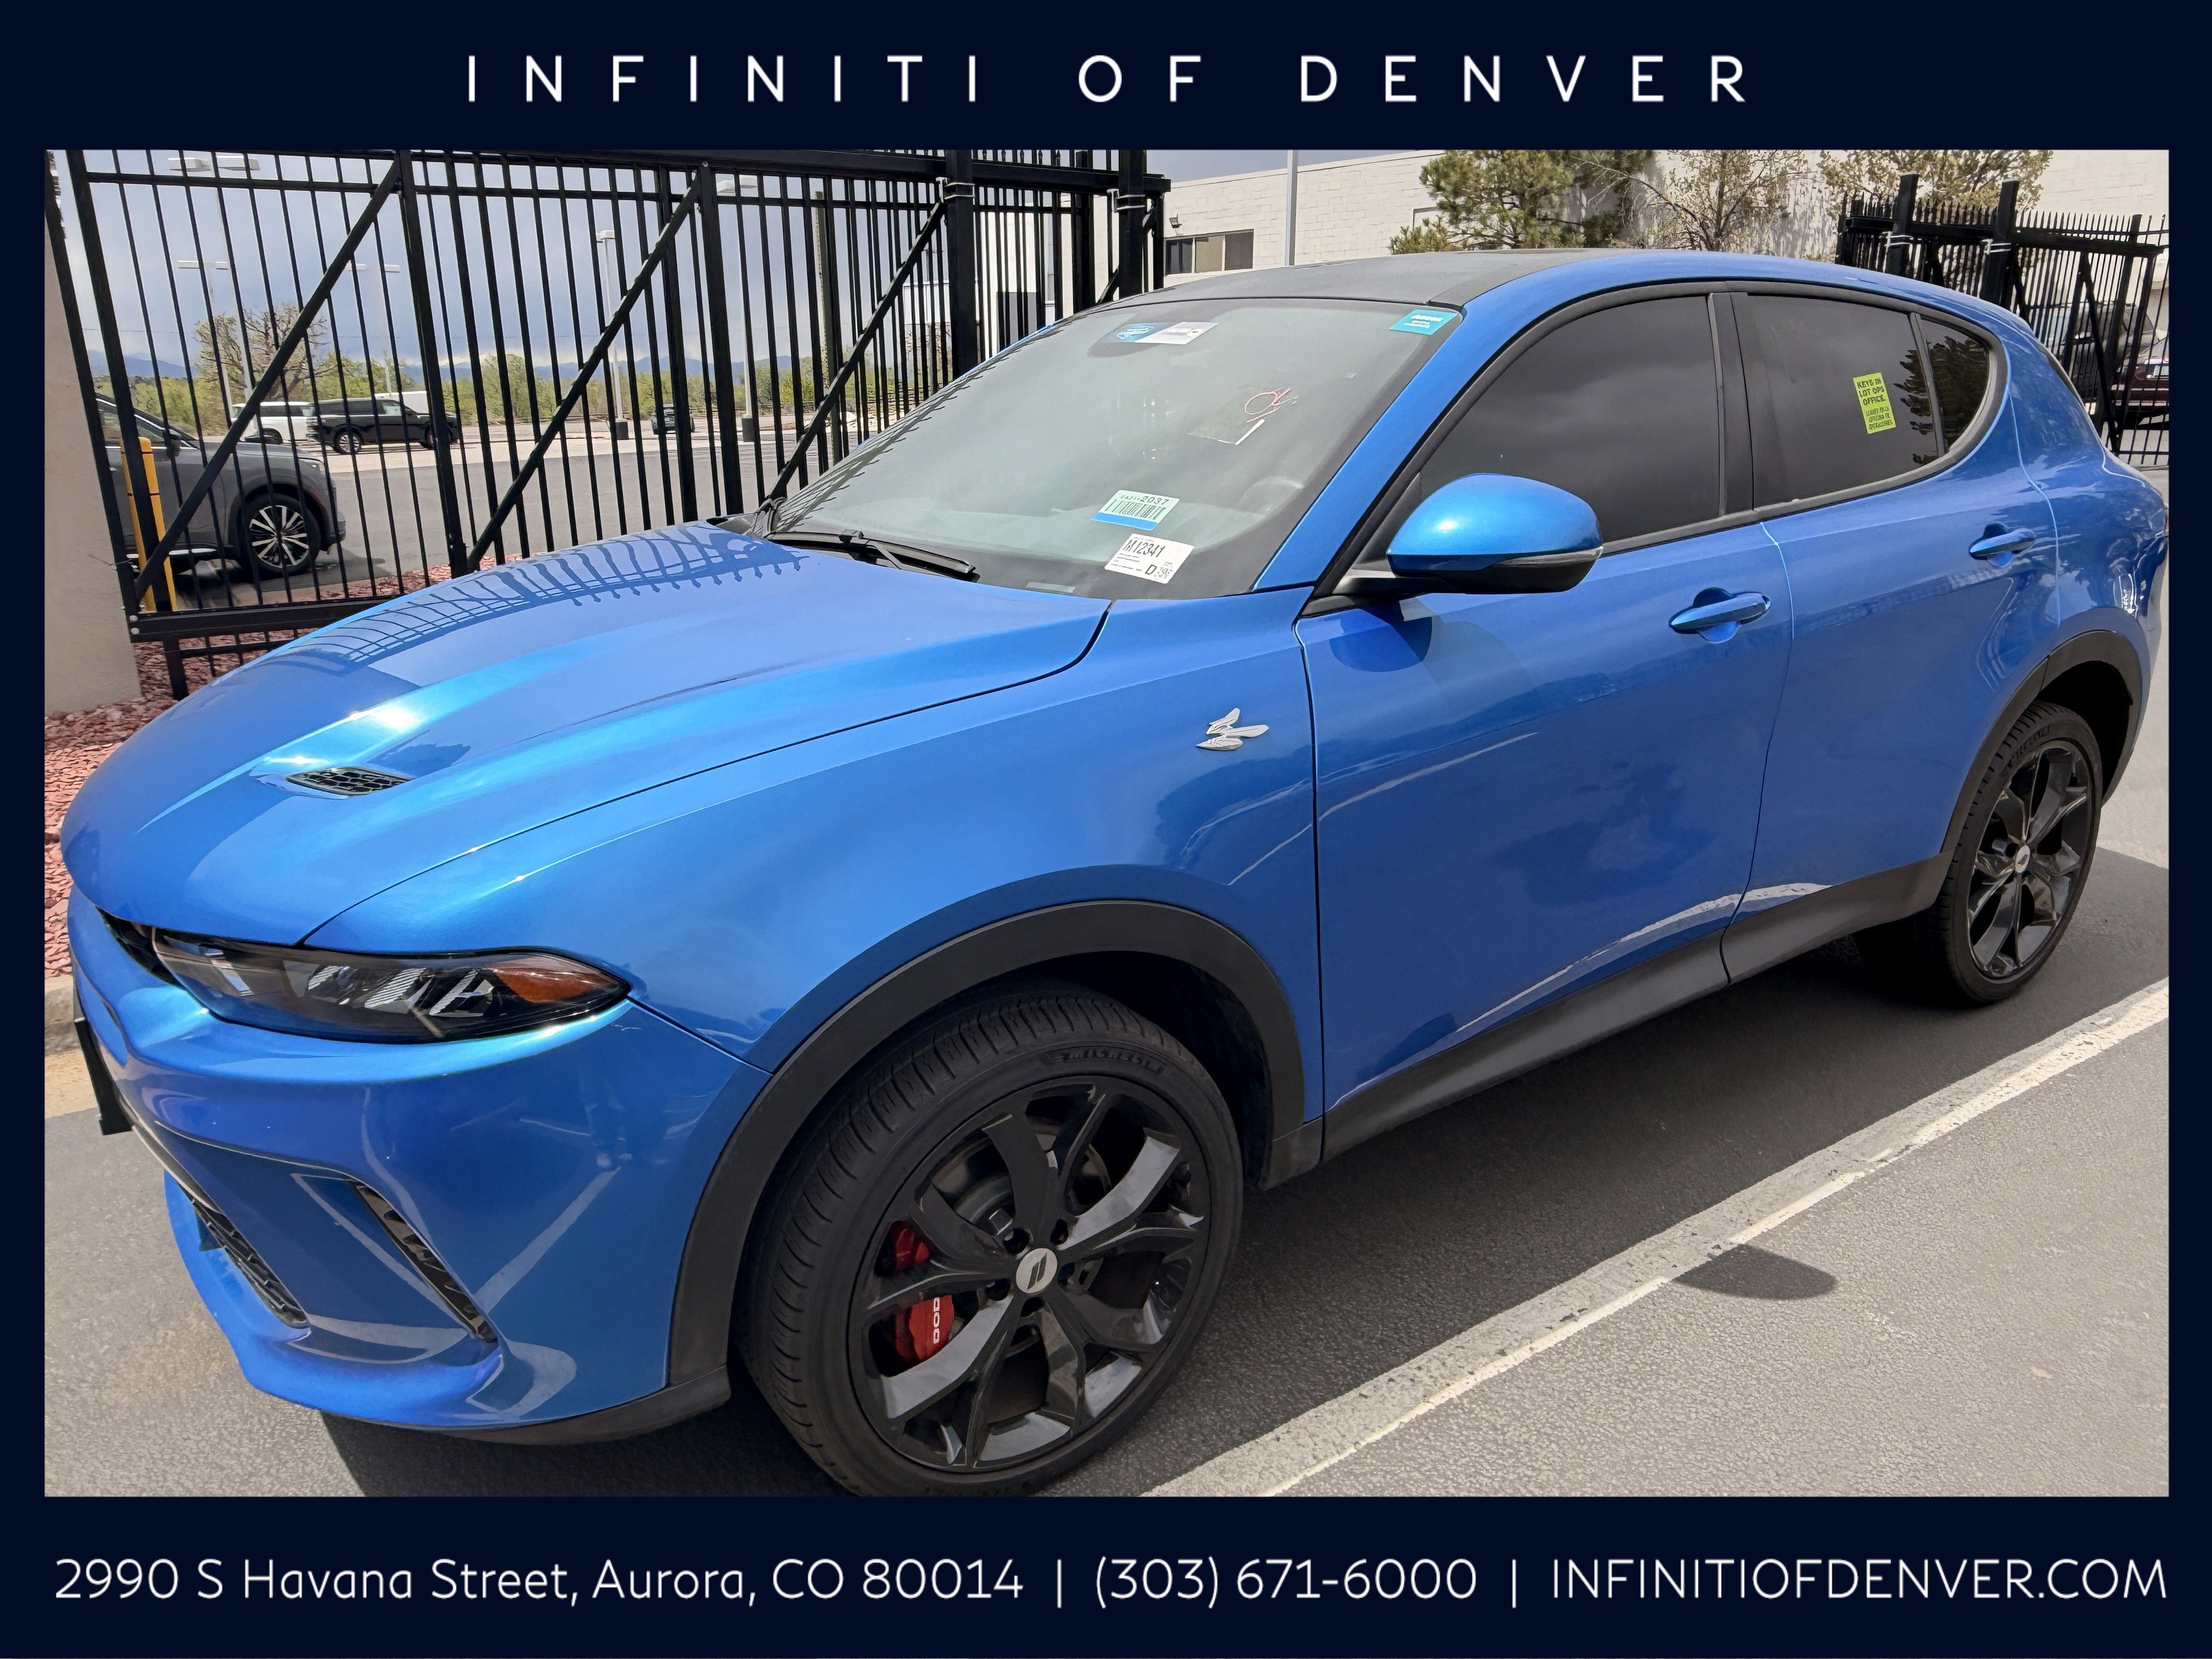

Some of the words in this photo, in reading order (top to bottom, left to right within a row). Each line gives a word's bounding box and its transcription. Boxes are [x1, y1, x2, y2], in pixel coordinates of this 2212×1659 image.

[1859, 388, 1871, 397] LOT
[1122, 539, 1166, 557] M12341
[1144, 564, 1158, 575] D
[1069, 1046, 1161, 1072] MICHELIN
